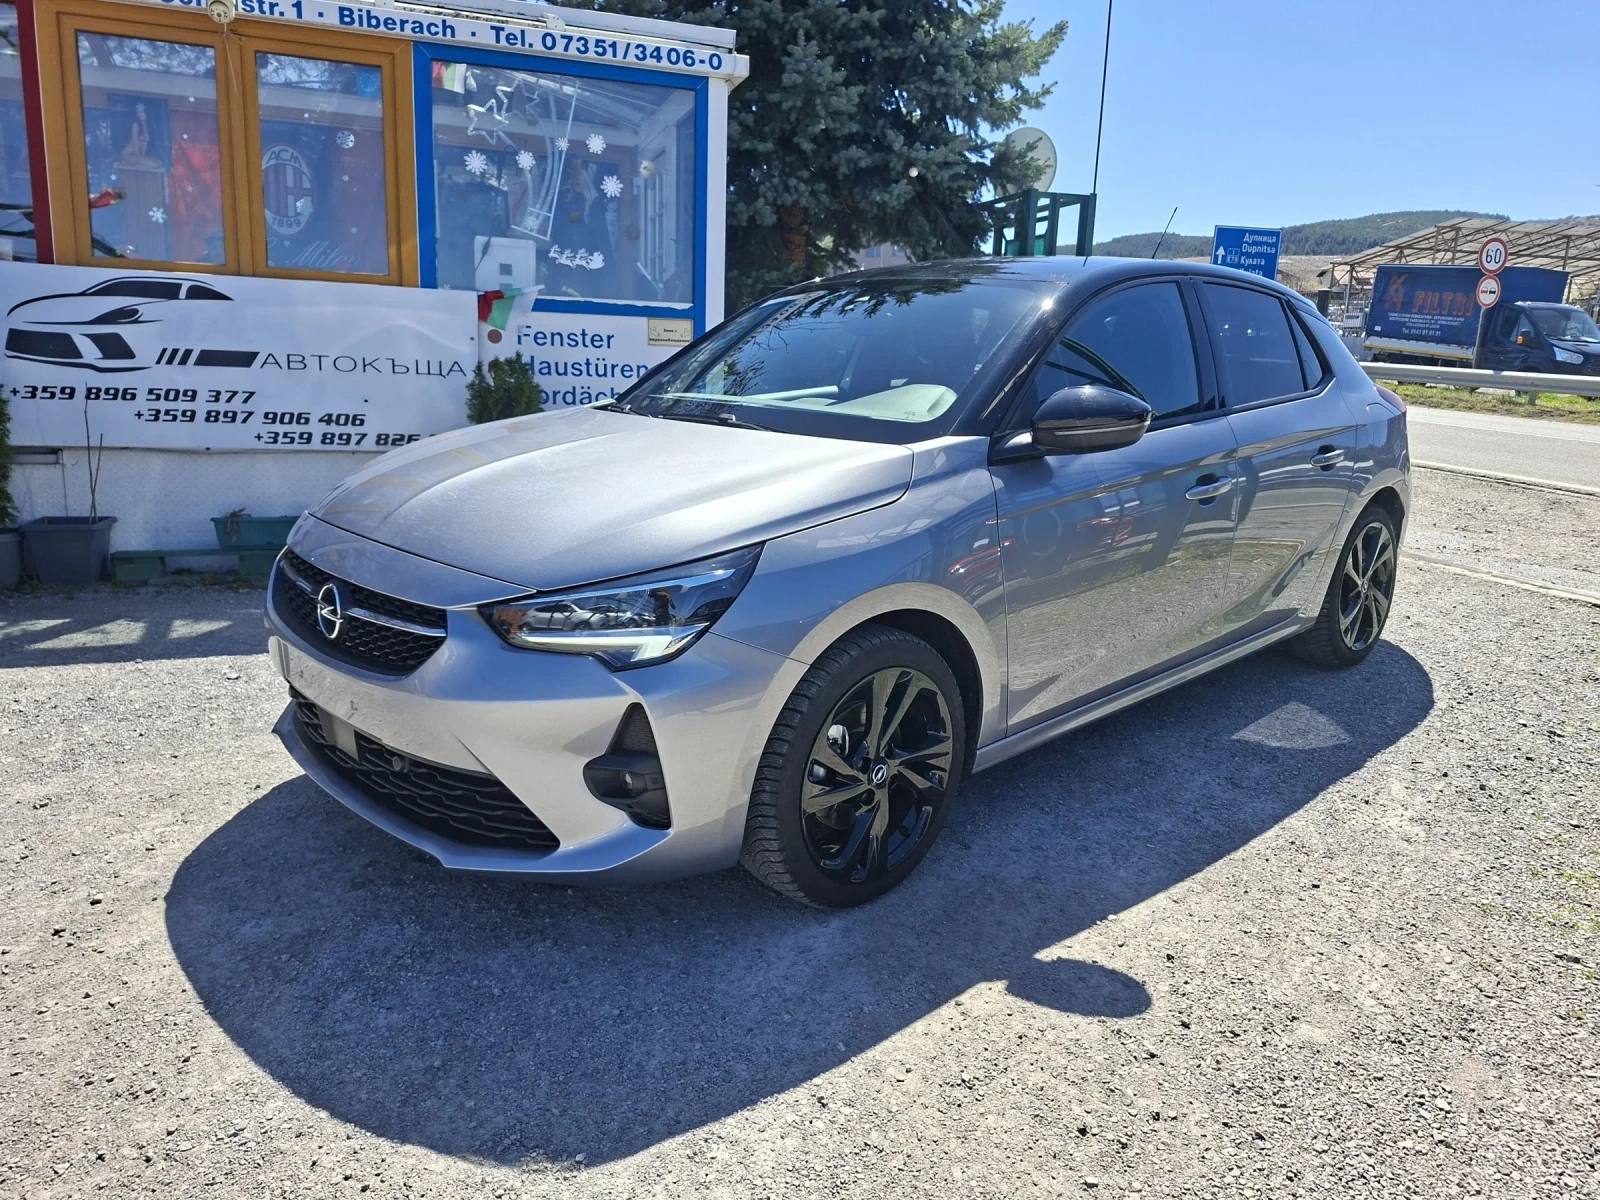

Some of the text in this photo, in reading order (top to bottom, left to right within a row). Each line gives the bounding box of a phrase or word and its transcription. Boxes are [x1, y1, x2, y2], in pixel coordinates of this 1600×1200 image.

[338, 6, 456, 39] Biberach
[490, 26, 534, 48] Tel.
[541, 32, 722, 70] 07351/3406-0
[266, 148, 301, 164] ACM
[1243, 232, 1277, 244] Дупница
[1241, 243, 1276, 254] Dupnitsa
[1485, 248, 1502, 264] 60
[1240, 256, 1265, 266] Кулата
[1411, 290, 1477, 317] FILTRI
[517, 325, 615, 349] Fenster
[260, 352, 467, 379] АВТОКЪЩА
[9, 385, 256, 404] +359 896 509 377
[134, 408, 367, 427] +359 897 906 406
[254, 431, 313, 445] +359
[320, 432, 368, 446] 897
